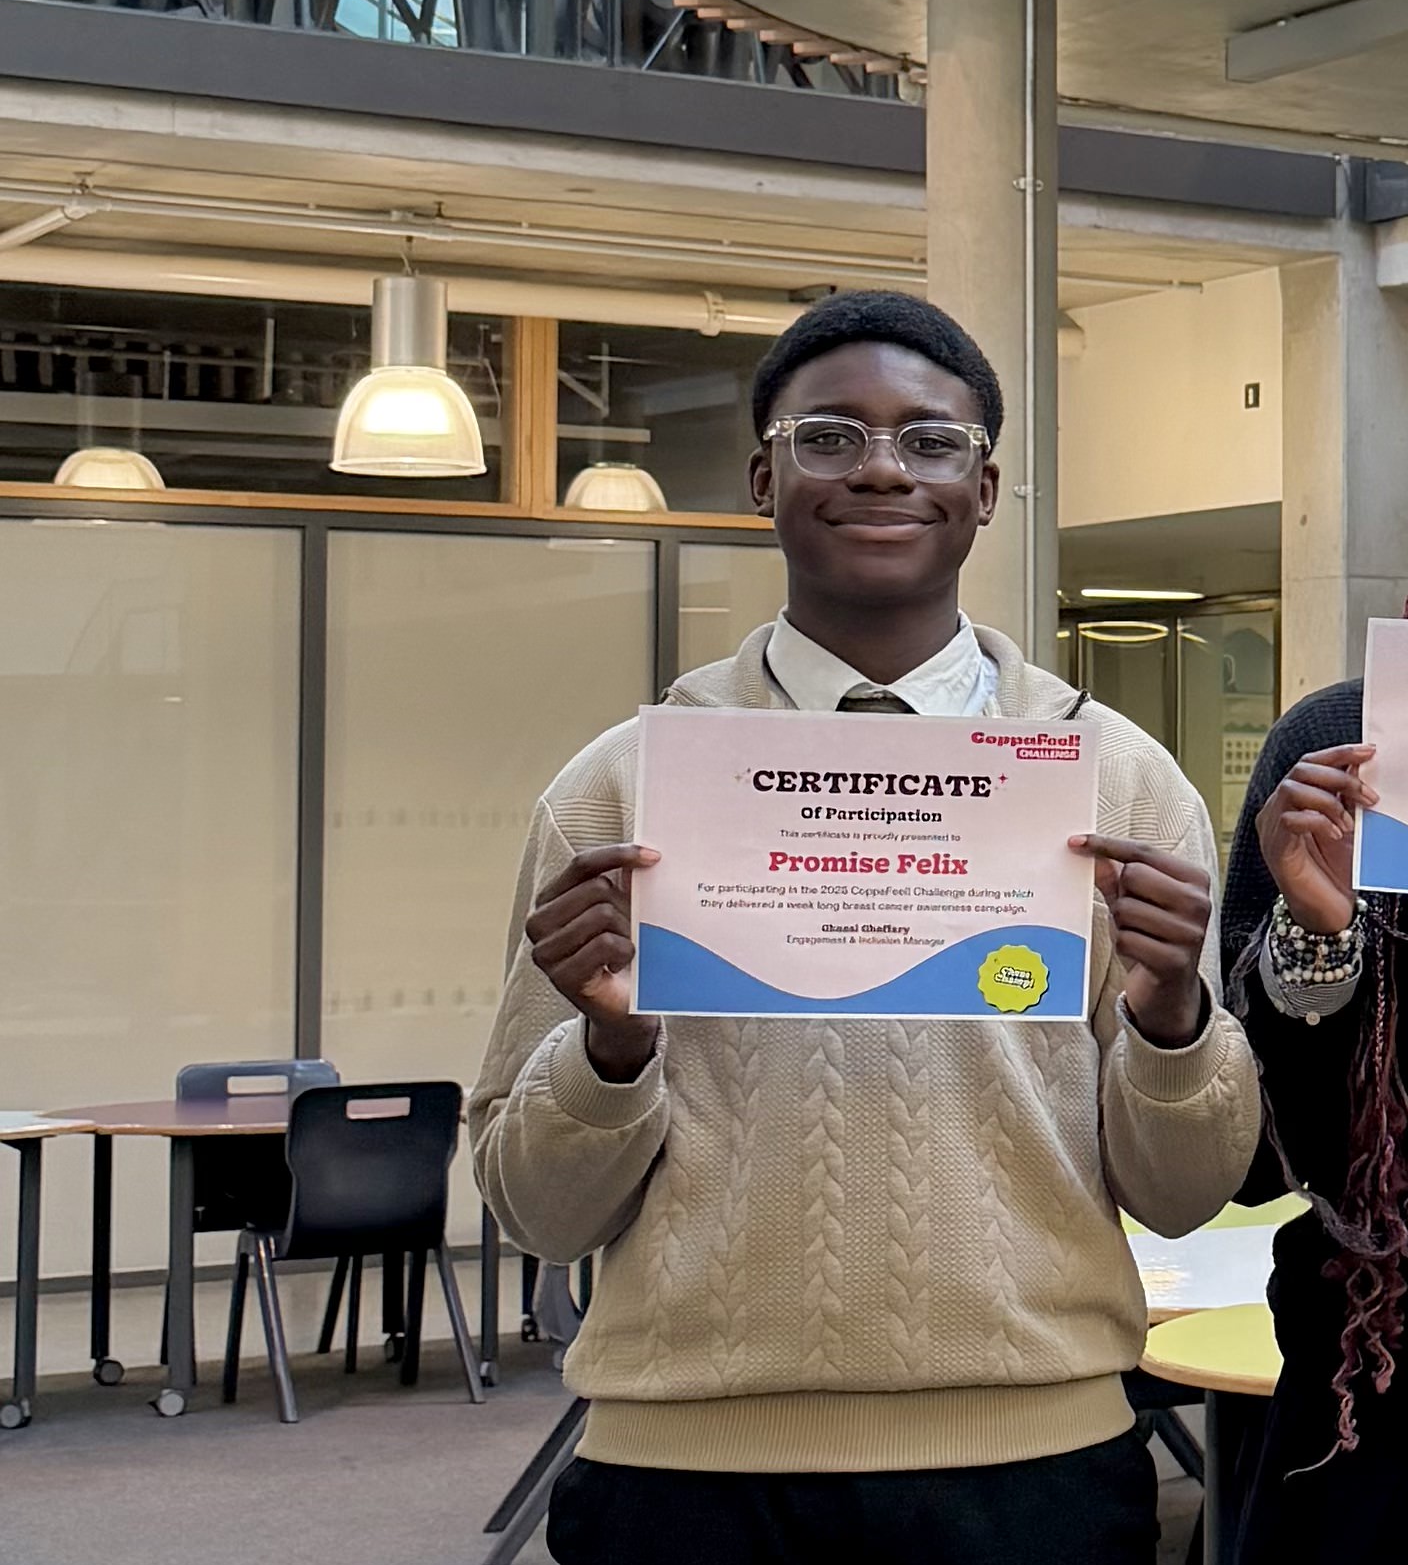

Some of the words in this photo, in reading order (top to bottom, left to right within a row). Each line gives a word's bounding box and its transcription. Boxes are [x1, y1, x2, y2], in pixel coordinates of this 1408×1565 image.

[971, 731, 1080, 748] CoppaFeel!
[753, 770, 991, 797] CERTIFICATE
[801, 806, 822, 819] Of
[825, 807, 942, 824] Participation
[768, 851, 890, 873] Promise
[896, 853, 968, 875] Felix
